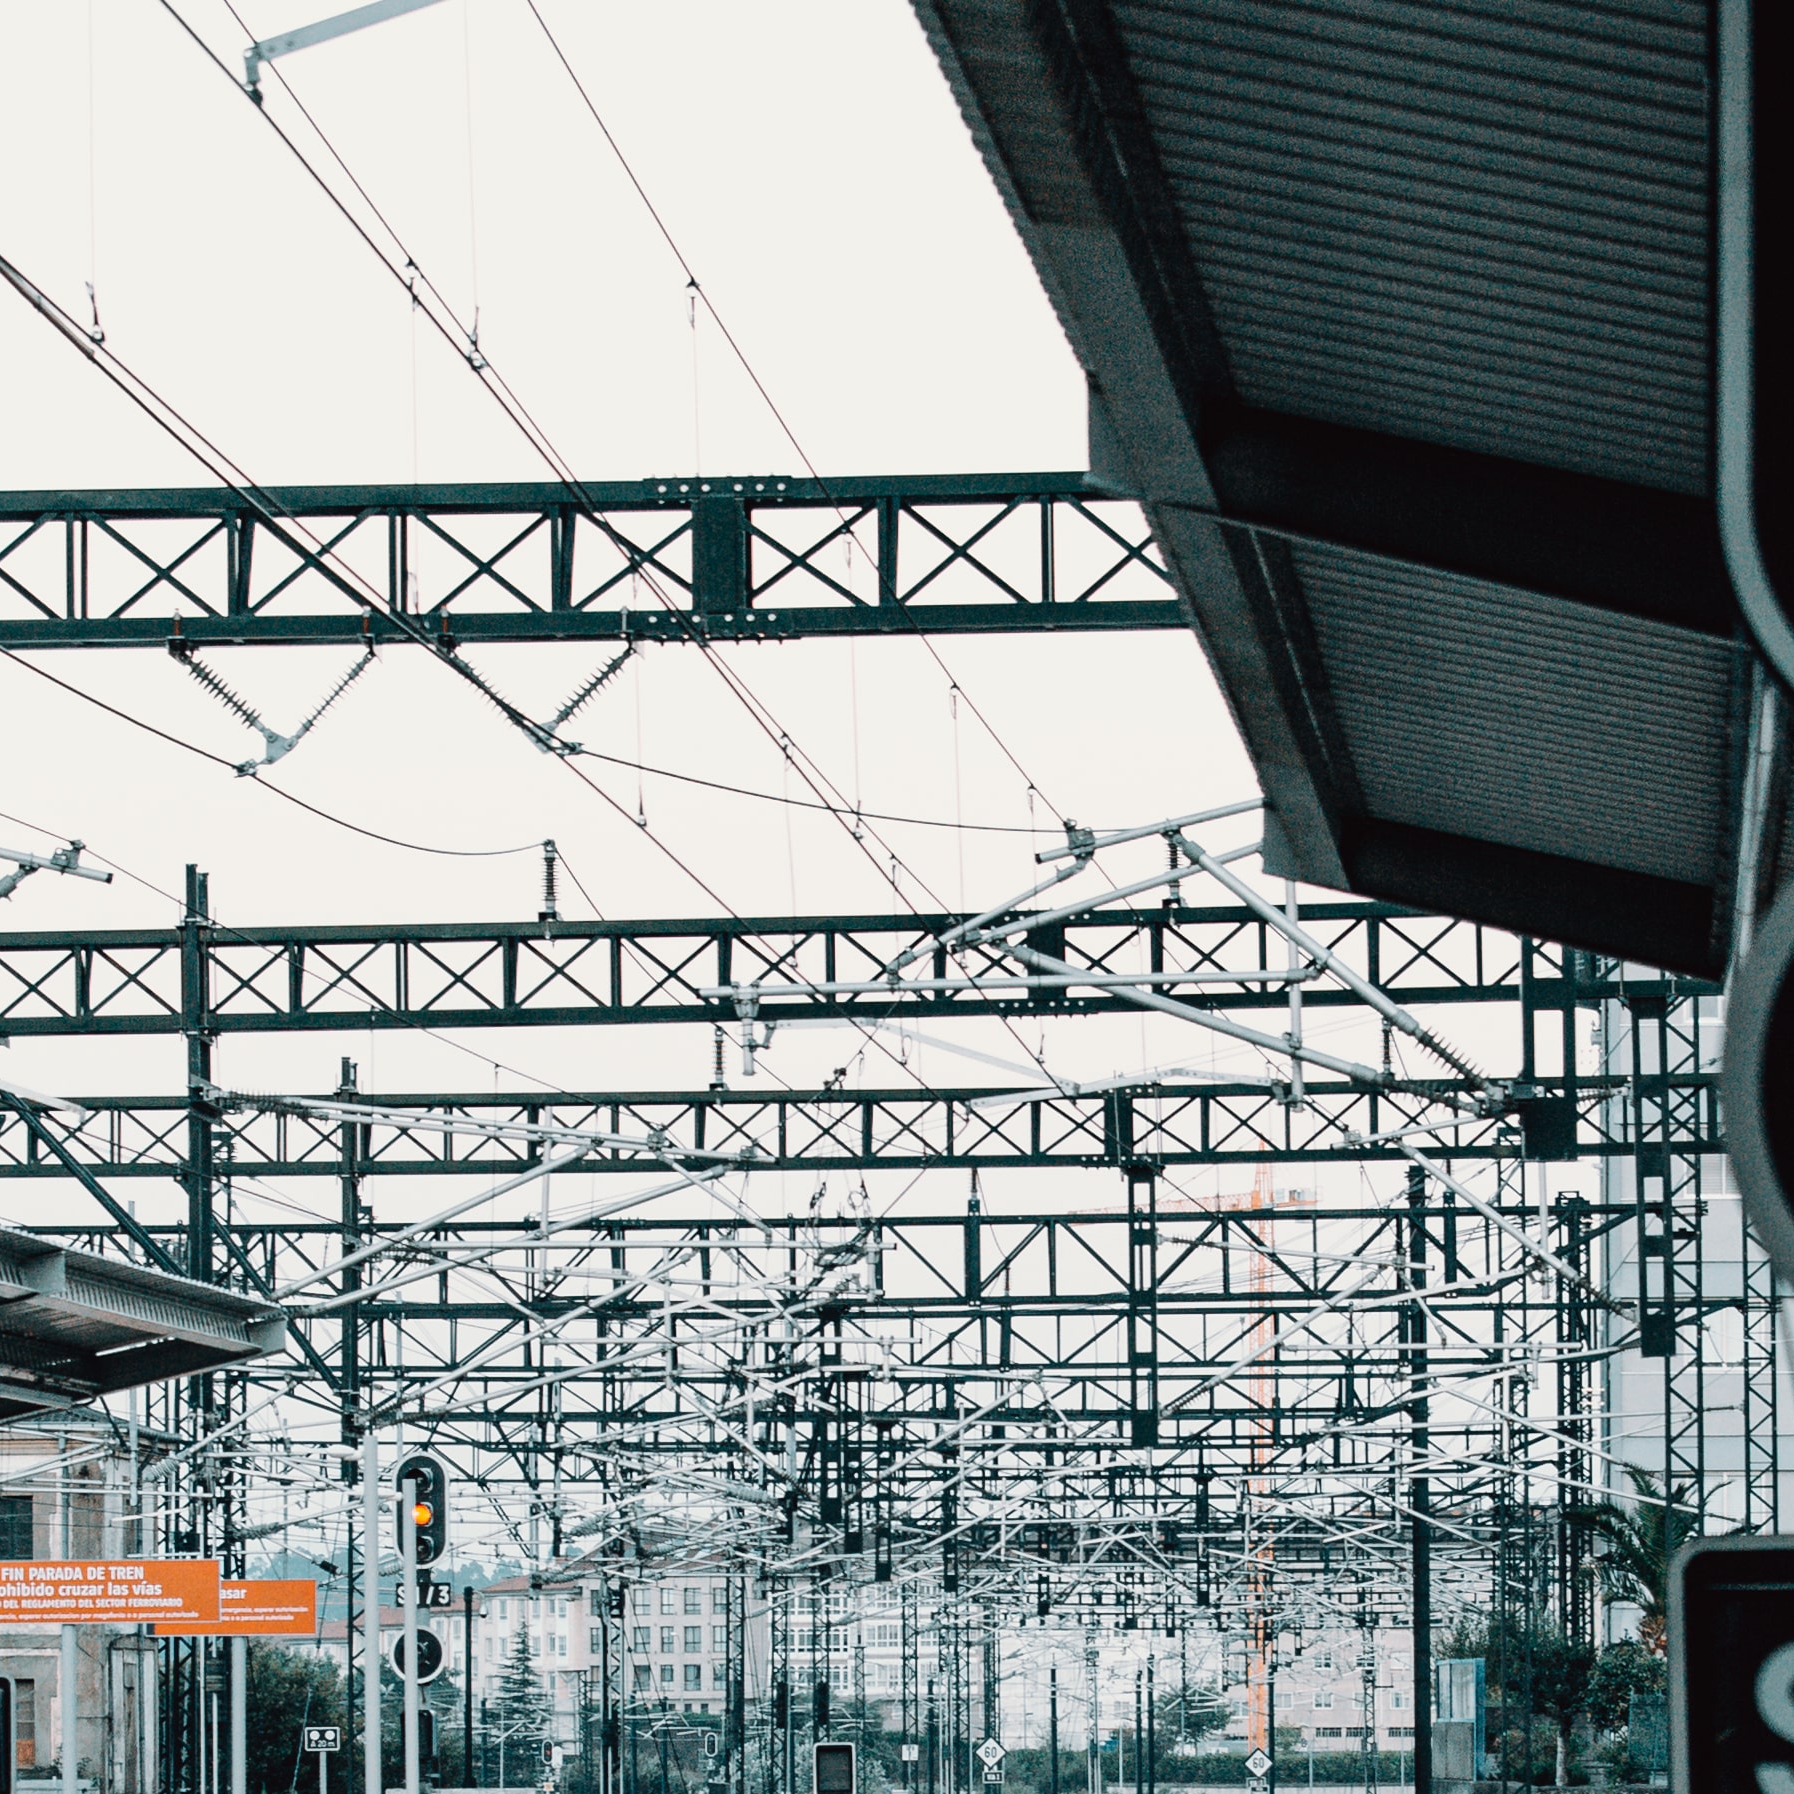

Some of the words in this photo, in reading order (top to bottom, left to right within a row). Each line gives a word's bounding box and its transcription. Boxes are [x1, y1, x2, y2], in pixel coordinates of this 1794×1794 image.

[1, 1567, 24, 1581] FIN
[29, 1566, 83, 1581] PARADA
[87, 1566, 106, 1580] DE
[108, 1566, 144, 1580] TREN
[58, 1584, 103, 1596] cruzar
[108, 1582, 129, 1595] las
[131, 1581, 163, 1595] vías
[984, 1747, 997, 1758] 60
[1253, 1757, 1264, 1768] 60
